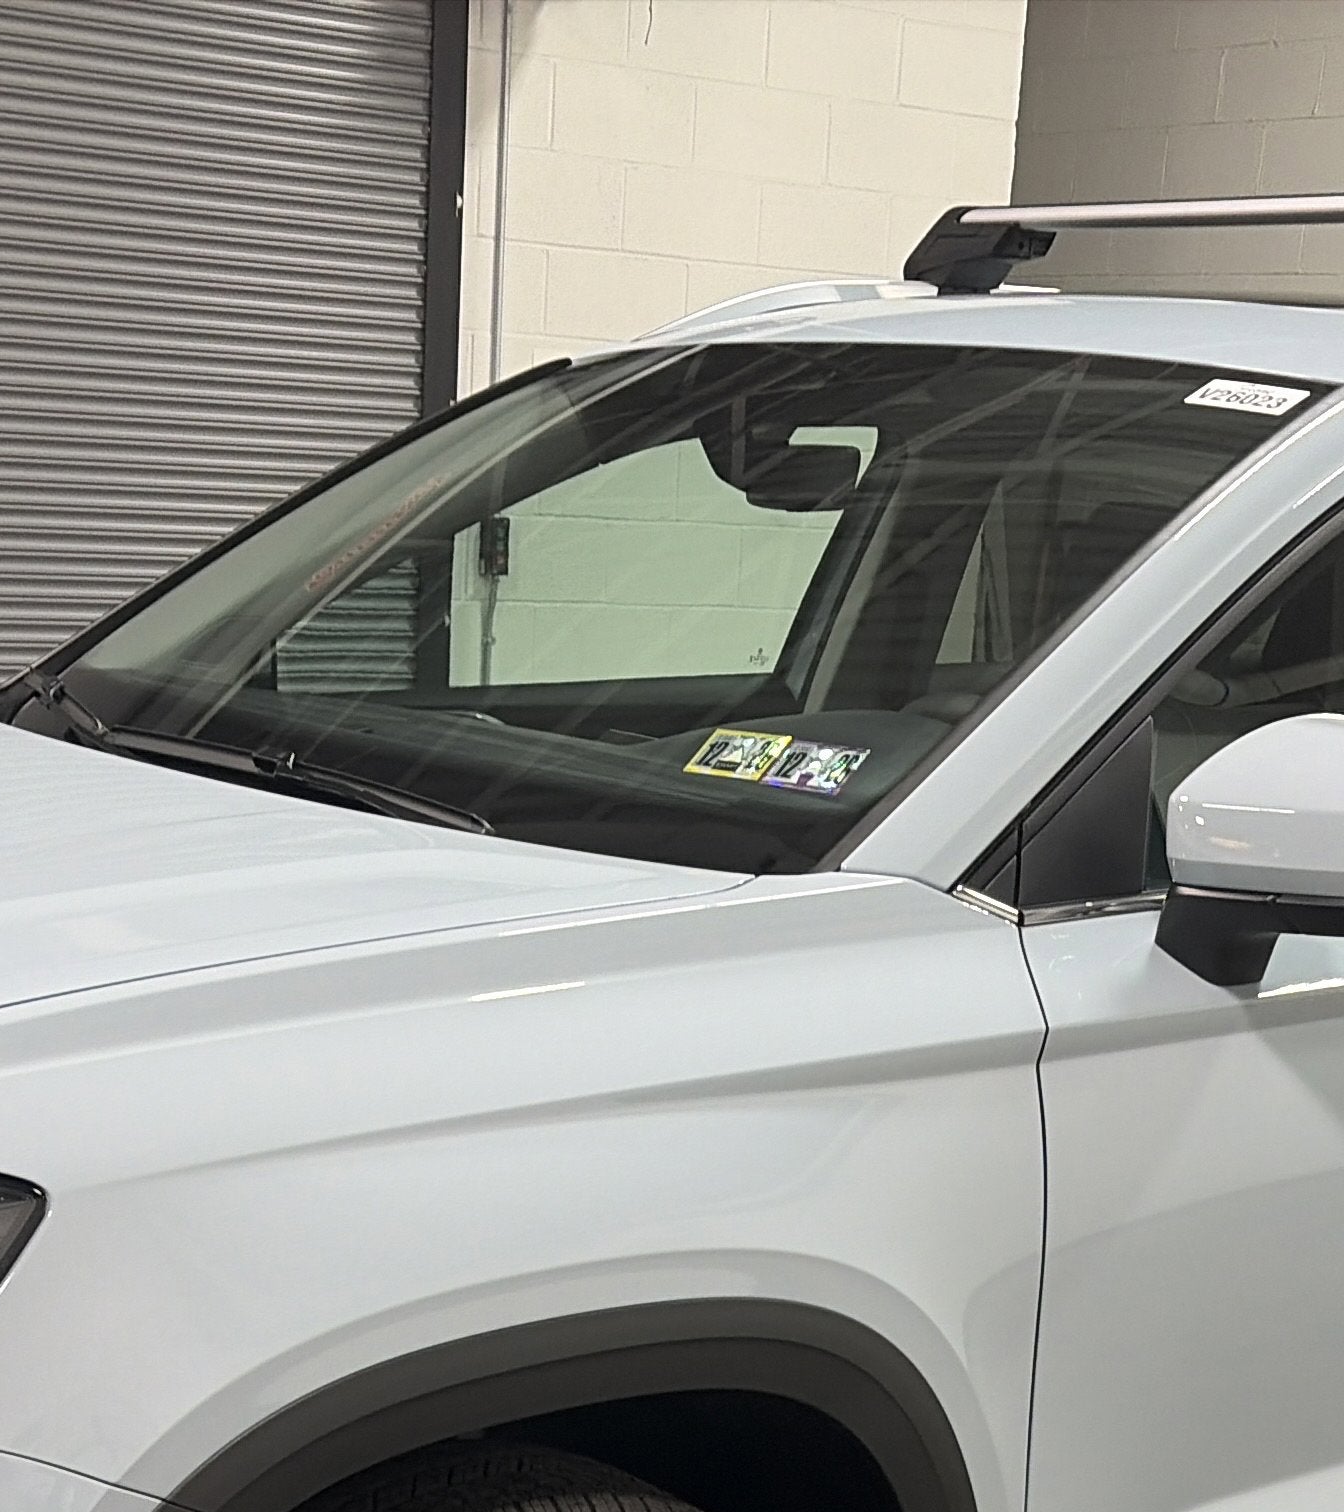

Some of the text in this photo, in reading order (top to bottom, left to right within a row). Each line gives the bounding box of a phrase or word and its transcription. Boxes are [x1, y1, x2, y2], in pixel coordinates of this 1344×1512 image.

[1199, 387, 1288, 409] V26023
[696, 741, 730, 767] 12
[775, 753, 808, 778] 12
